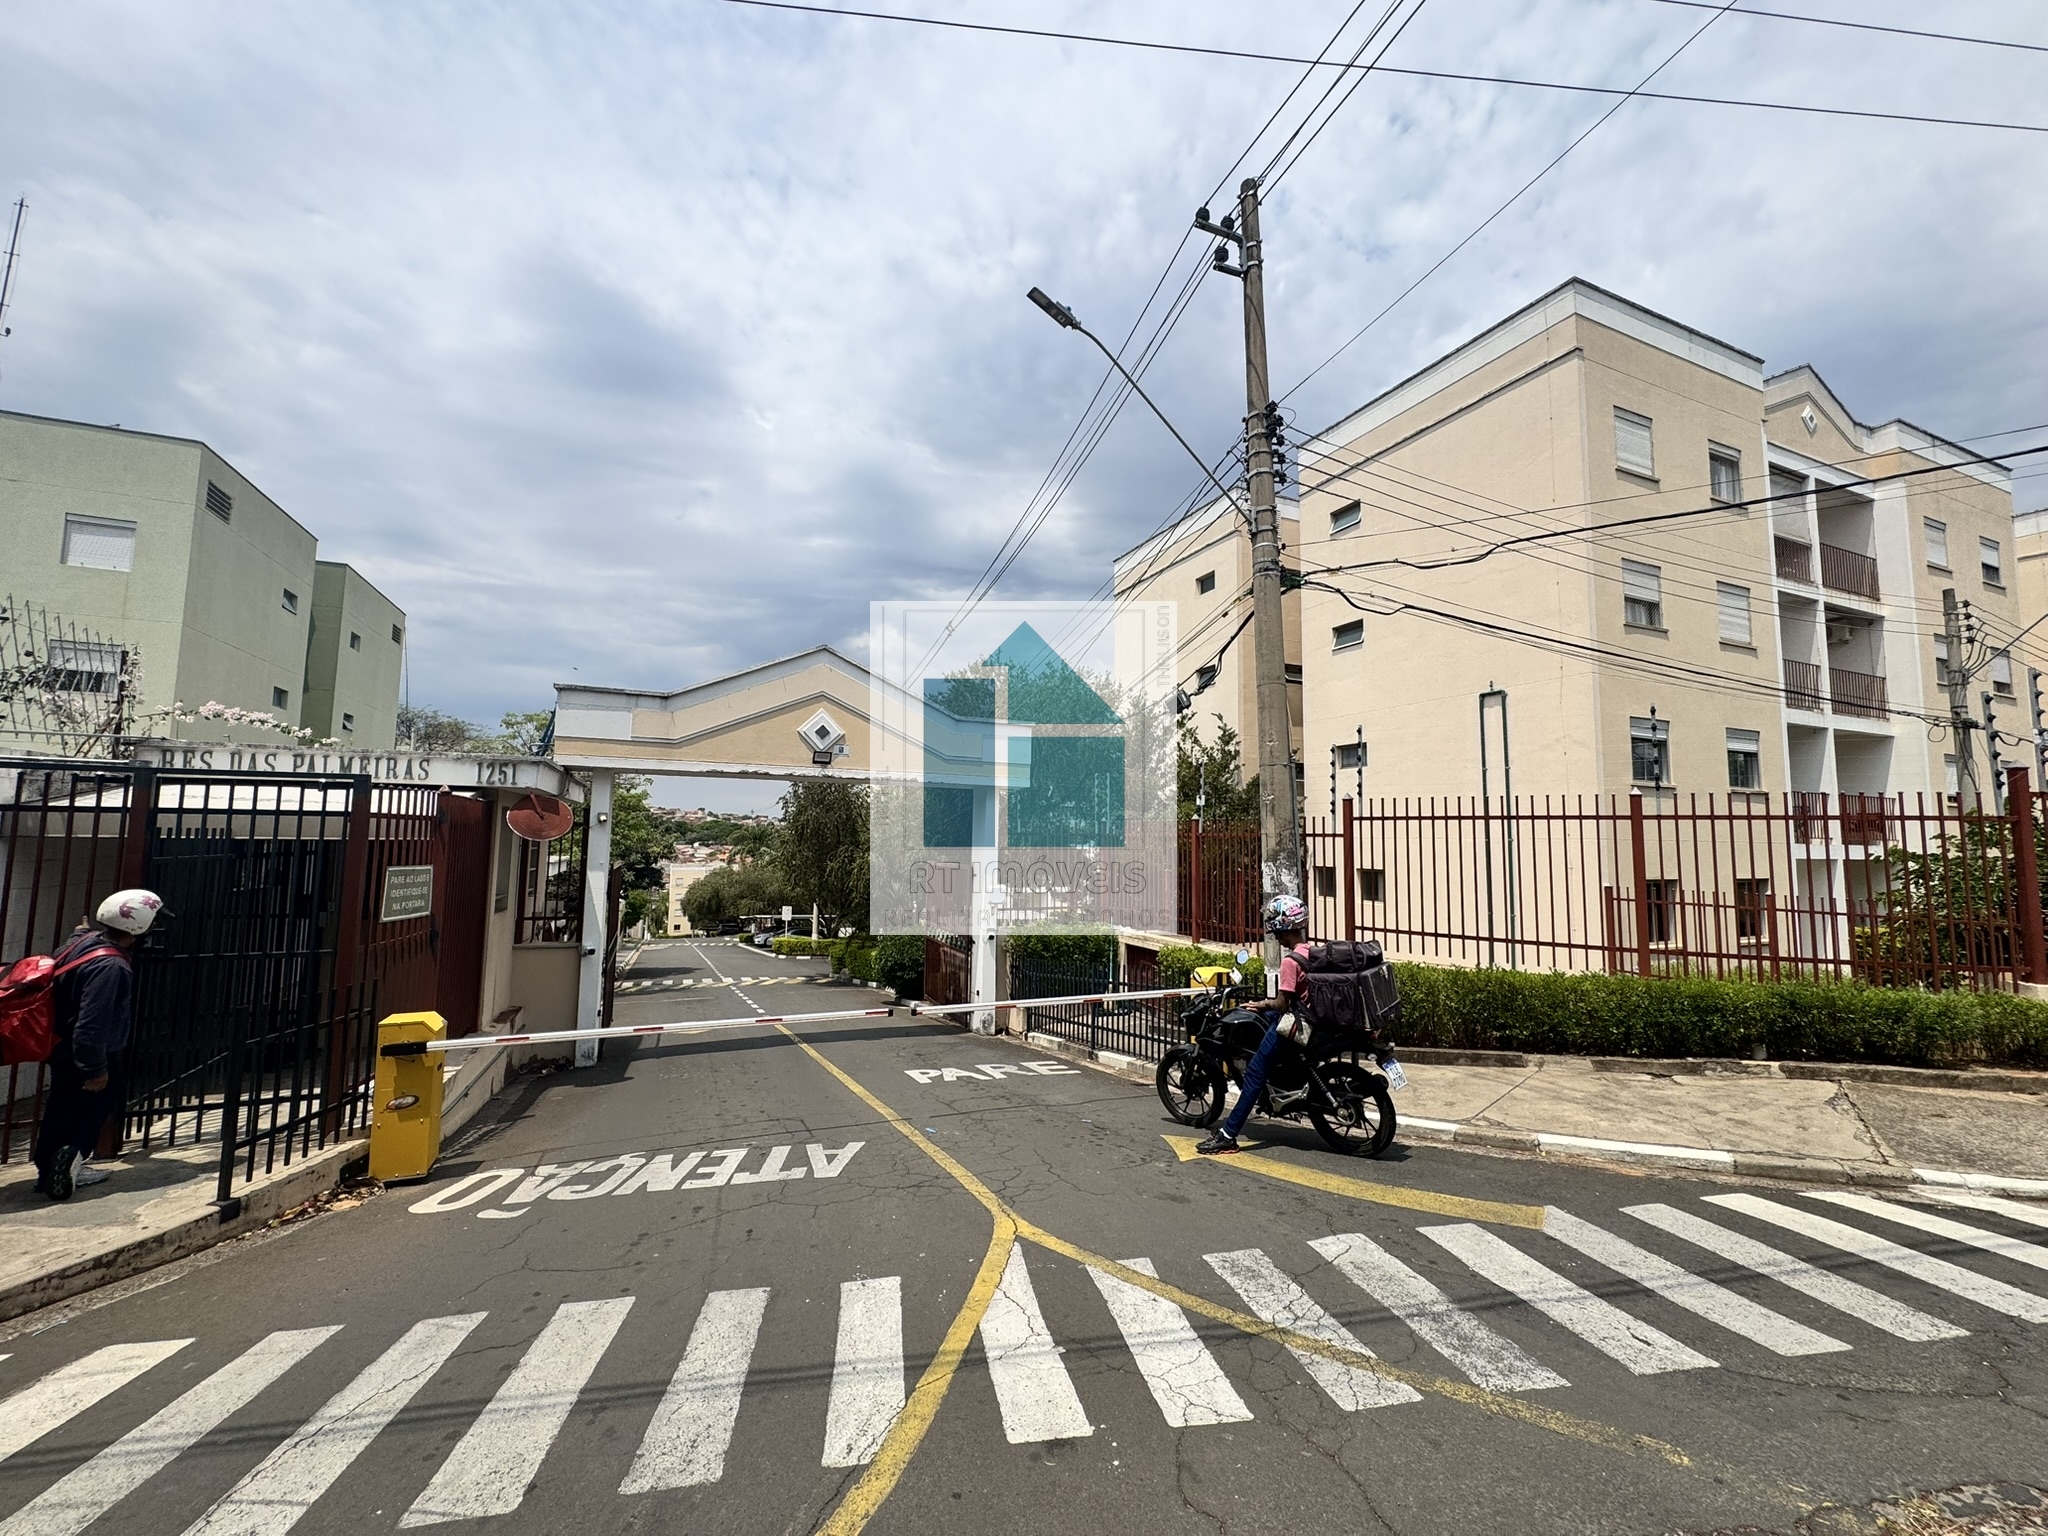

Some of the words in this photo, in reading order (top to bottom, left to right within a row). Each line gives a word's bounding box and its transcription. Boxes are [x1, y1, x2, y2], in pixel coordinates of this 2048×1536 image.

[160, 750, 214, 769] RES
[229, 751, 278, 772] DAS
[291, 753, 431, 781] PALMEIRAS
[475, 761, 518, 786] 1251
[390, 876, 405, 884] PARE
[406, 875, 414, 883] AO
[402, 900, 424, 909] PORTARIA
[903, 1060, 1082, 1084] PARE
[407, 1140, 867, 1219] ATENÇÃO
